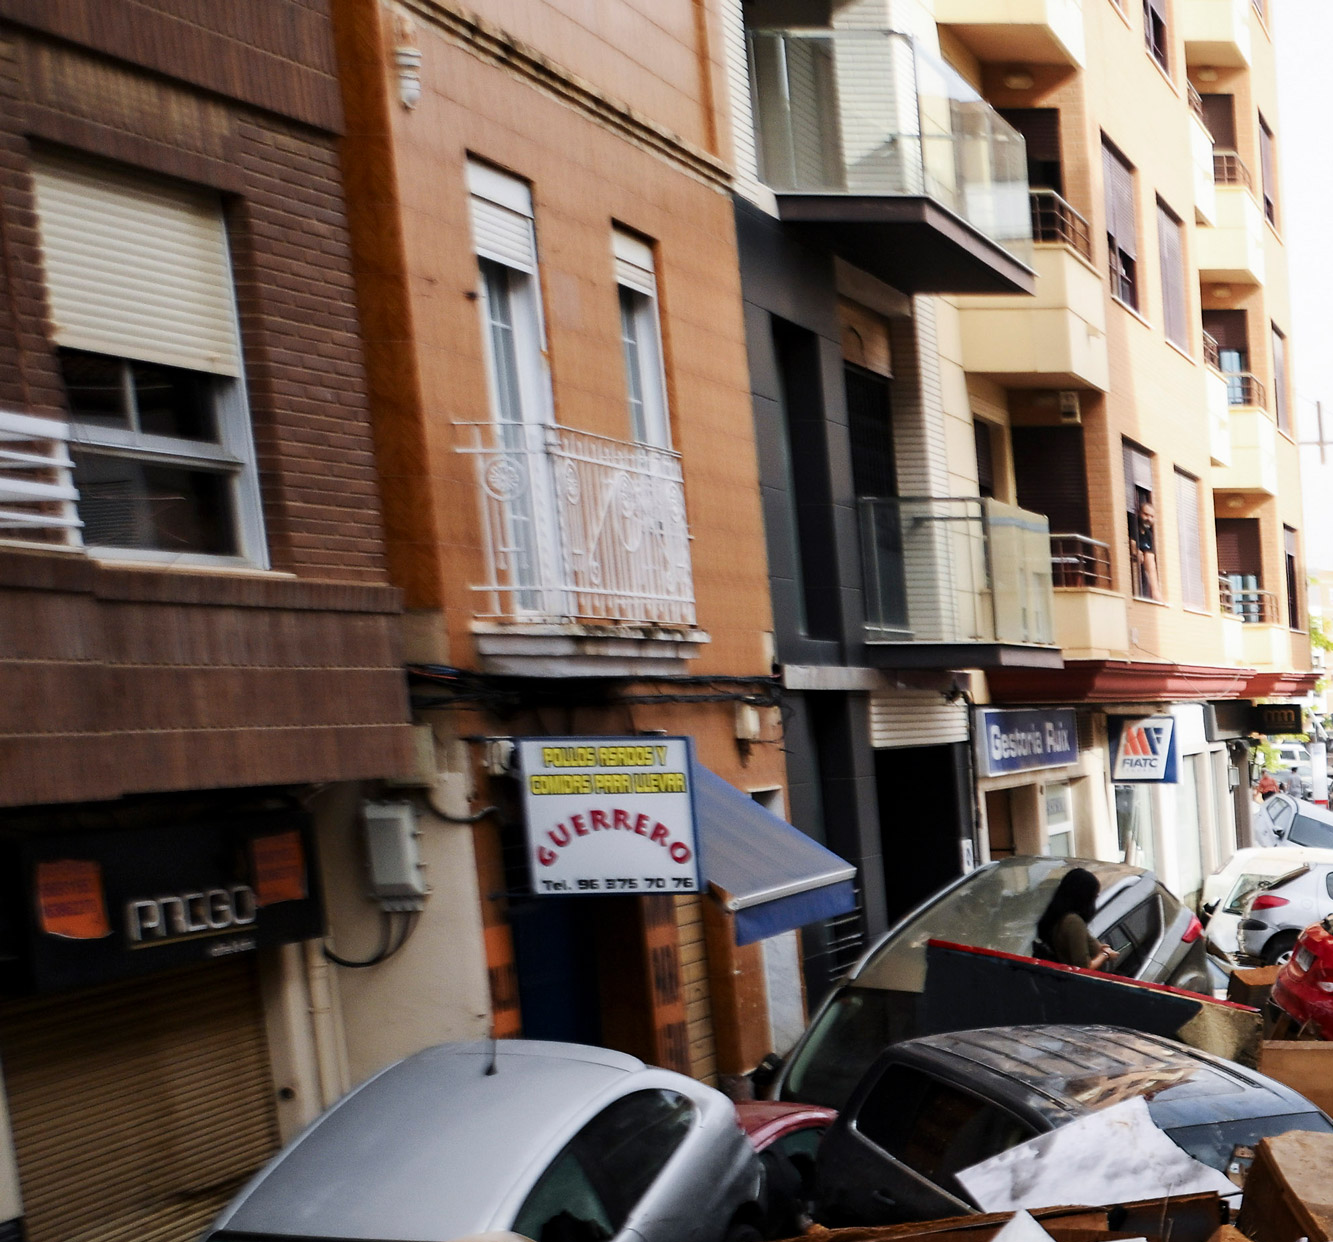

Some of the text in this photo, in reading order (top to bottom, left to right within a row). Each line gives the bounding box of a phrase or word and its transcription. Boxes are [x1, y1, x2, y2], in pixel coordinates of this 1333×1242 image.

[542, 746, 667, 767] POLLOS ASADOS Y
[1122, 758, 1158, 768] FIATC
[530, 772, 687, 795] COMIDAS PARA LLEVAR
[536, 809, 691, 867] GUERRERO
[542, 877, 693, 891] Tel. 96 375 70 76
